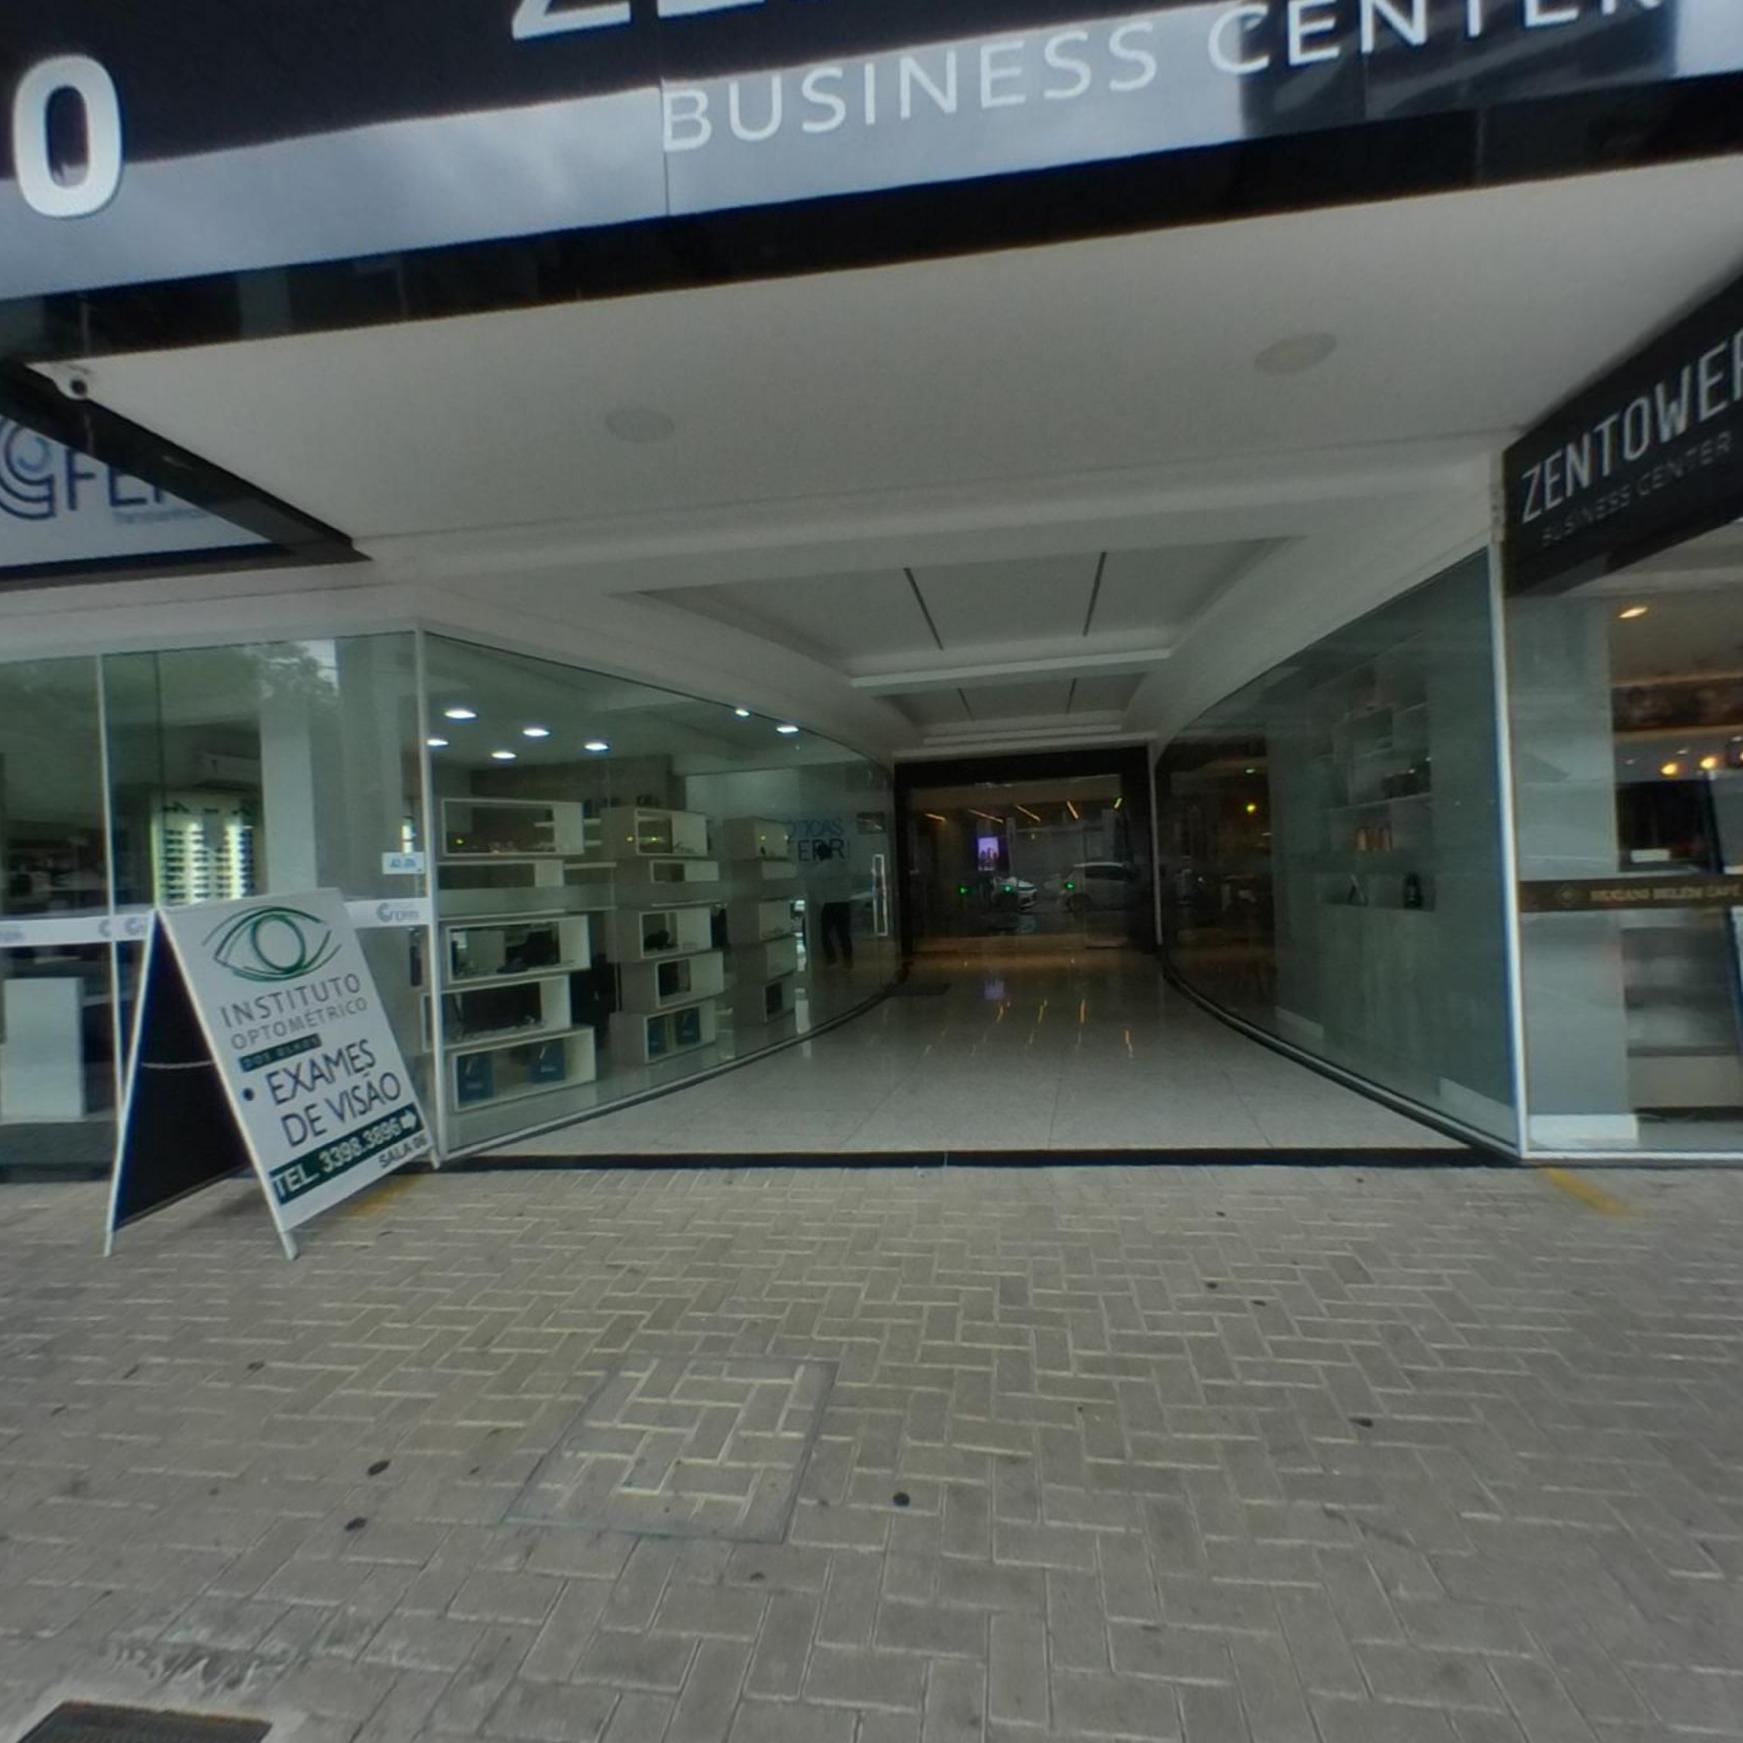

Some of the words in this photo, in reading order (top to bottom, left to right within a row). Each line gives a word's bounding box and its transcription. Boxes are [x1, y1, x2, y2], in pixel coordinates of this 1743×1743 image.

[661, 20, 1158, 153] BUSINESS
[1207, 0, 1662, 75] CEN
[1636, 430, 1732, 497] CENTER
[219, 973, 361, 1028] INSTITUTO
[231, 997, 368, 1050] OPTOMÉTRICO
[266, 1039, 376, 1105] EXAMES
[281, 1104, 328, 1147] DE
[325, 1070, 402, 1124] VISÃO
